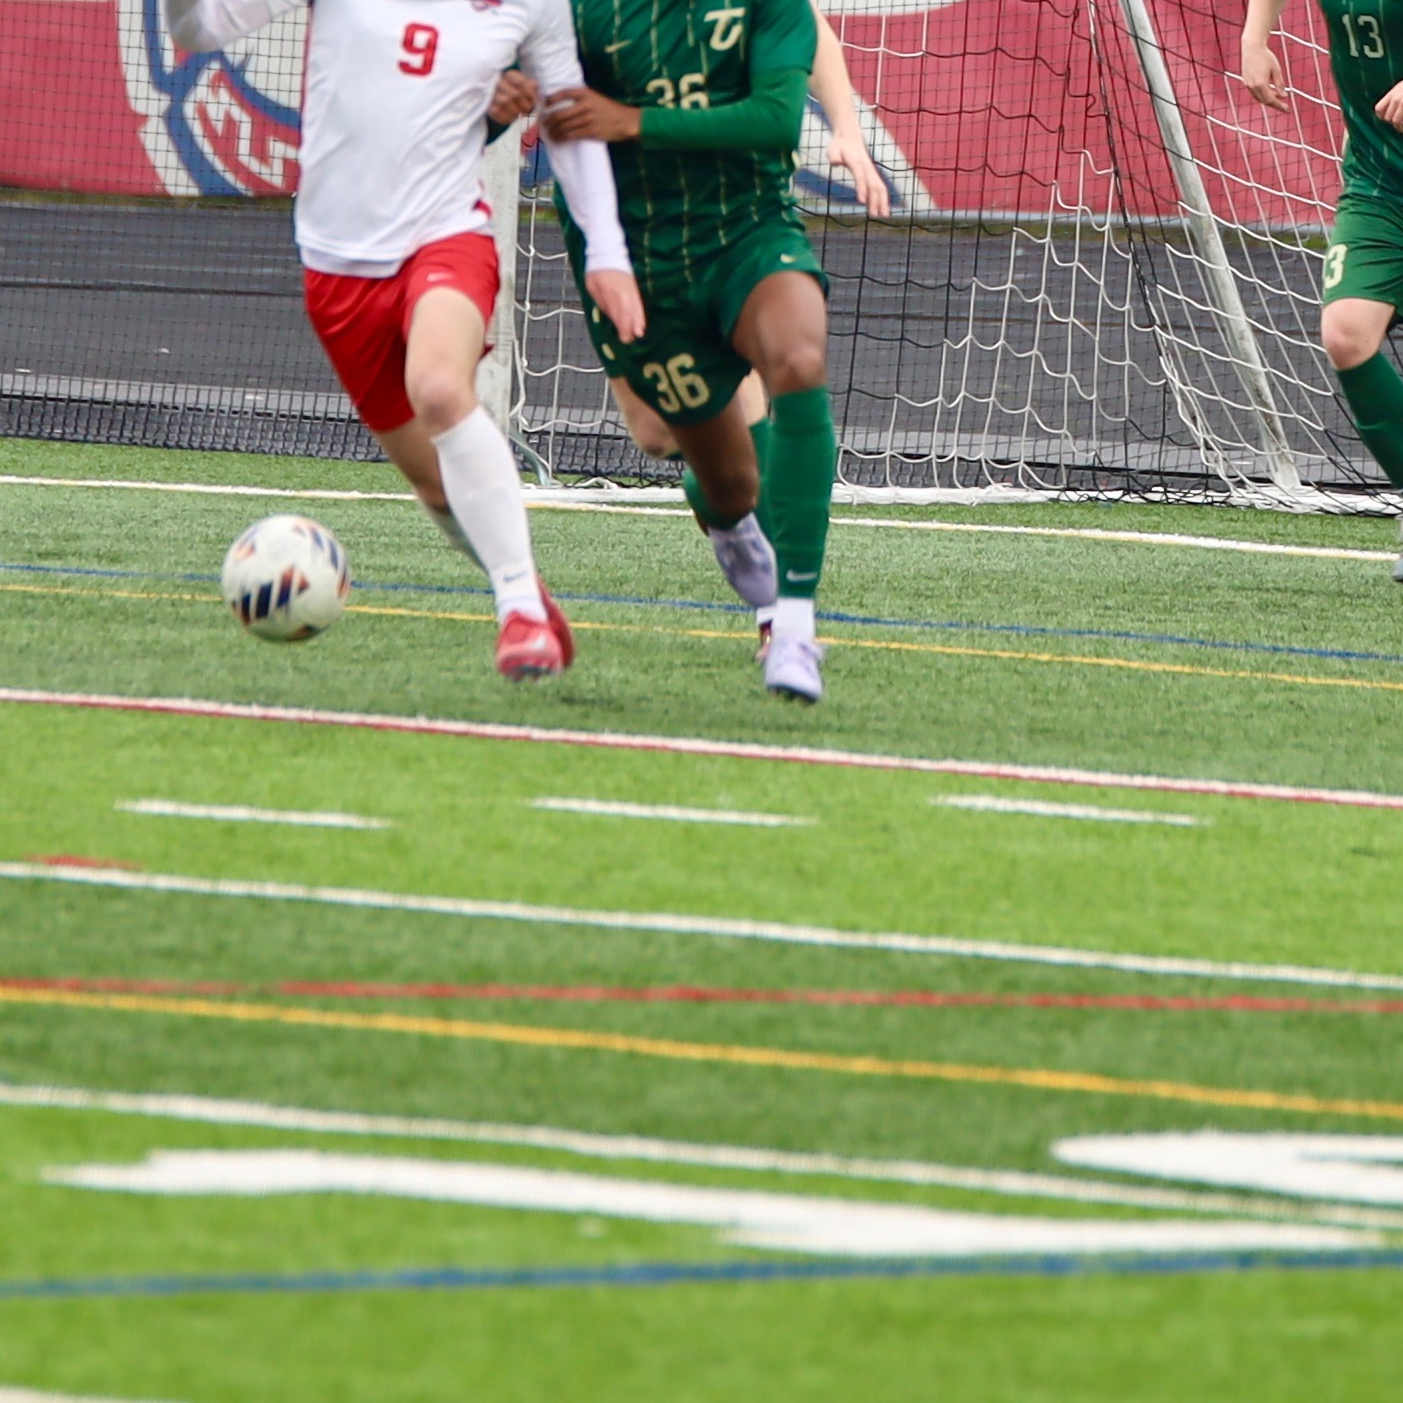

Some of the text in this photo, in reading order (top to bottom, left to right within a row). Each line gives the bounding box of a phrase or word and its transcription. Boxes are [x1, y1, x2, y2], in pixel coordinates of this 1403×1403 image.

[397, 22, 439, 77] 9
[1341, 13, 1385, 59] 13
[642, 352, 712, 415] 36
